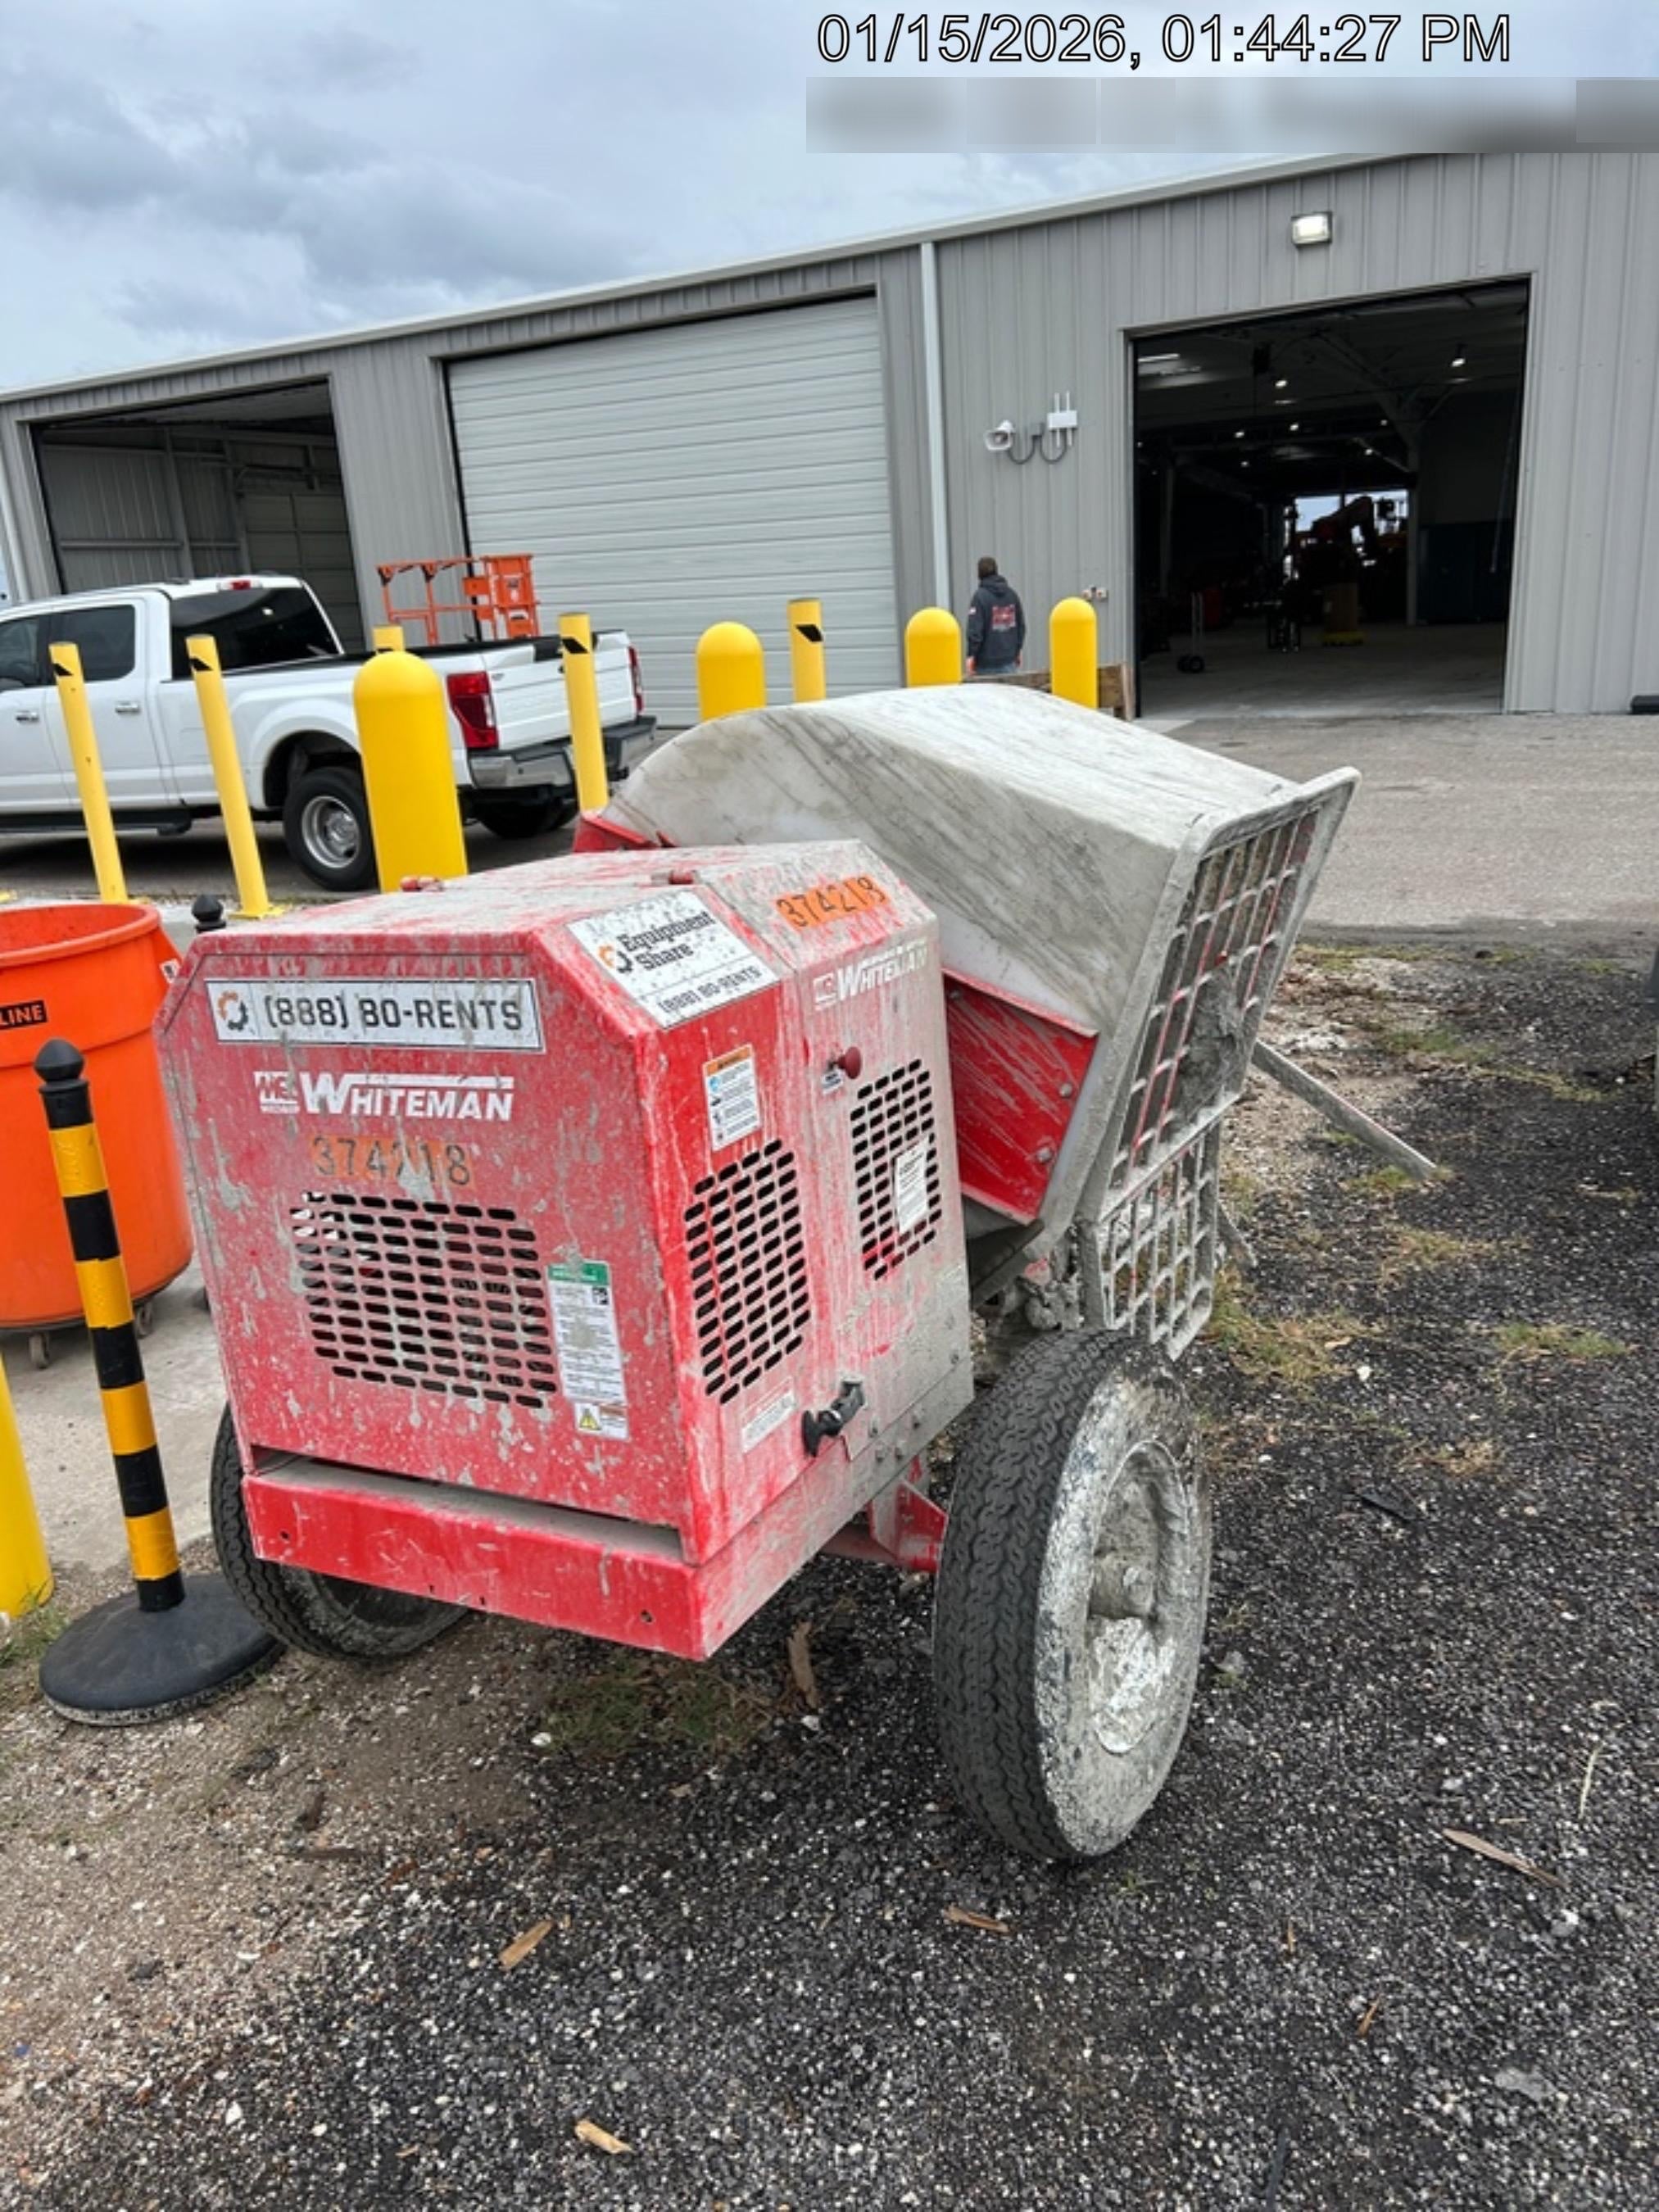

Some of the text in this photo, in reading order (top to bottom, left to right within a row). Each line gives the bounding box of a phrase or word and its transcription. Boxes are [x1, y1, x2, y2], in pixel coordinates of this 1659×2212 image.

[616, 910, 716, 952] Equipment
[634, 943, 695, 971] Share
[836, 937, 927, 1001] WHITEAN
[264, 995, 349, 1030] (888)
[299, 1072, 514, 1122] WHITEMAN
